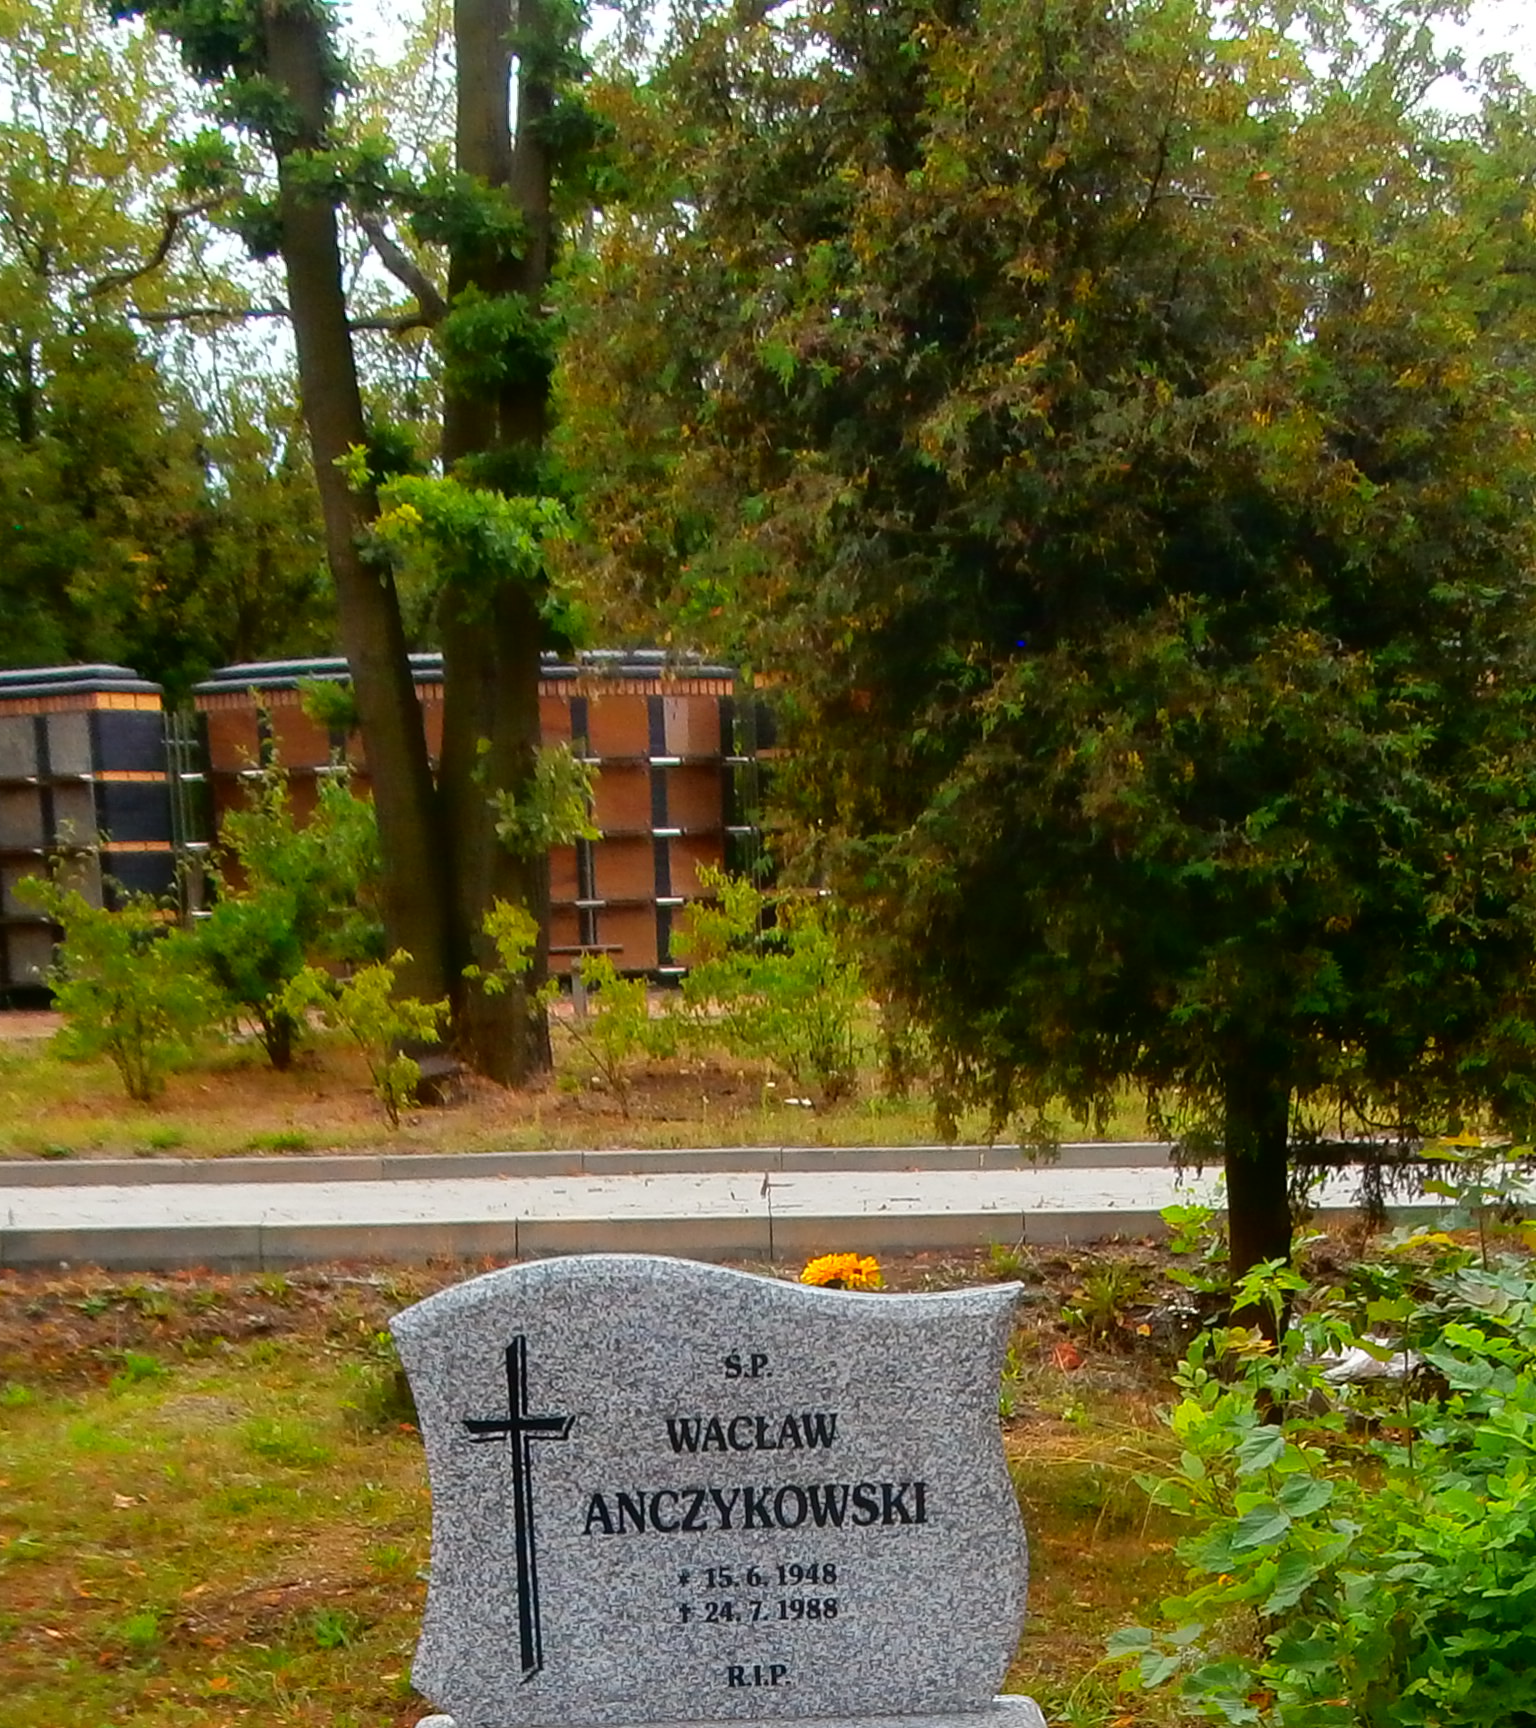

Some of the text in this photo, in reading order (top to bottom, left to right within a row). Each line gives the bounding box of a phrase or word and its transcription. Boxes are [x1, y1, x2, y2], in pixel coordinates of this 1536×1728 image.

[666, 1413, 838, 1453] WACŁAW
[582, 1482, 928, 1535] ANCZYKOWSKI
[776, 1563, 838, 1586] 1948
[777, 1598, 838, 1620] 1988
